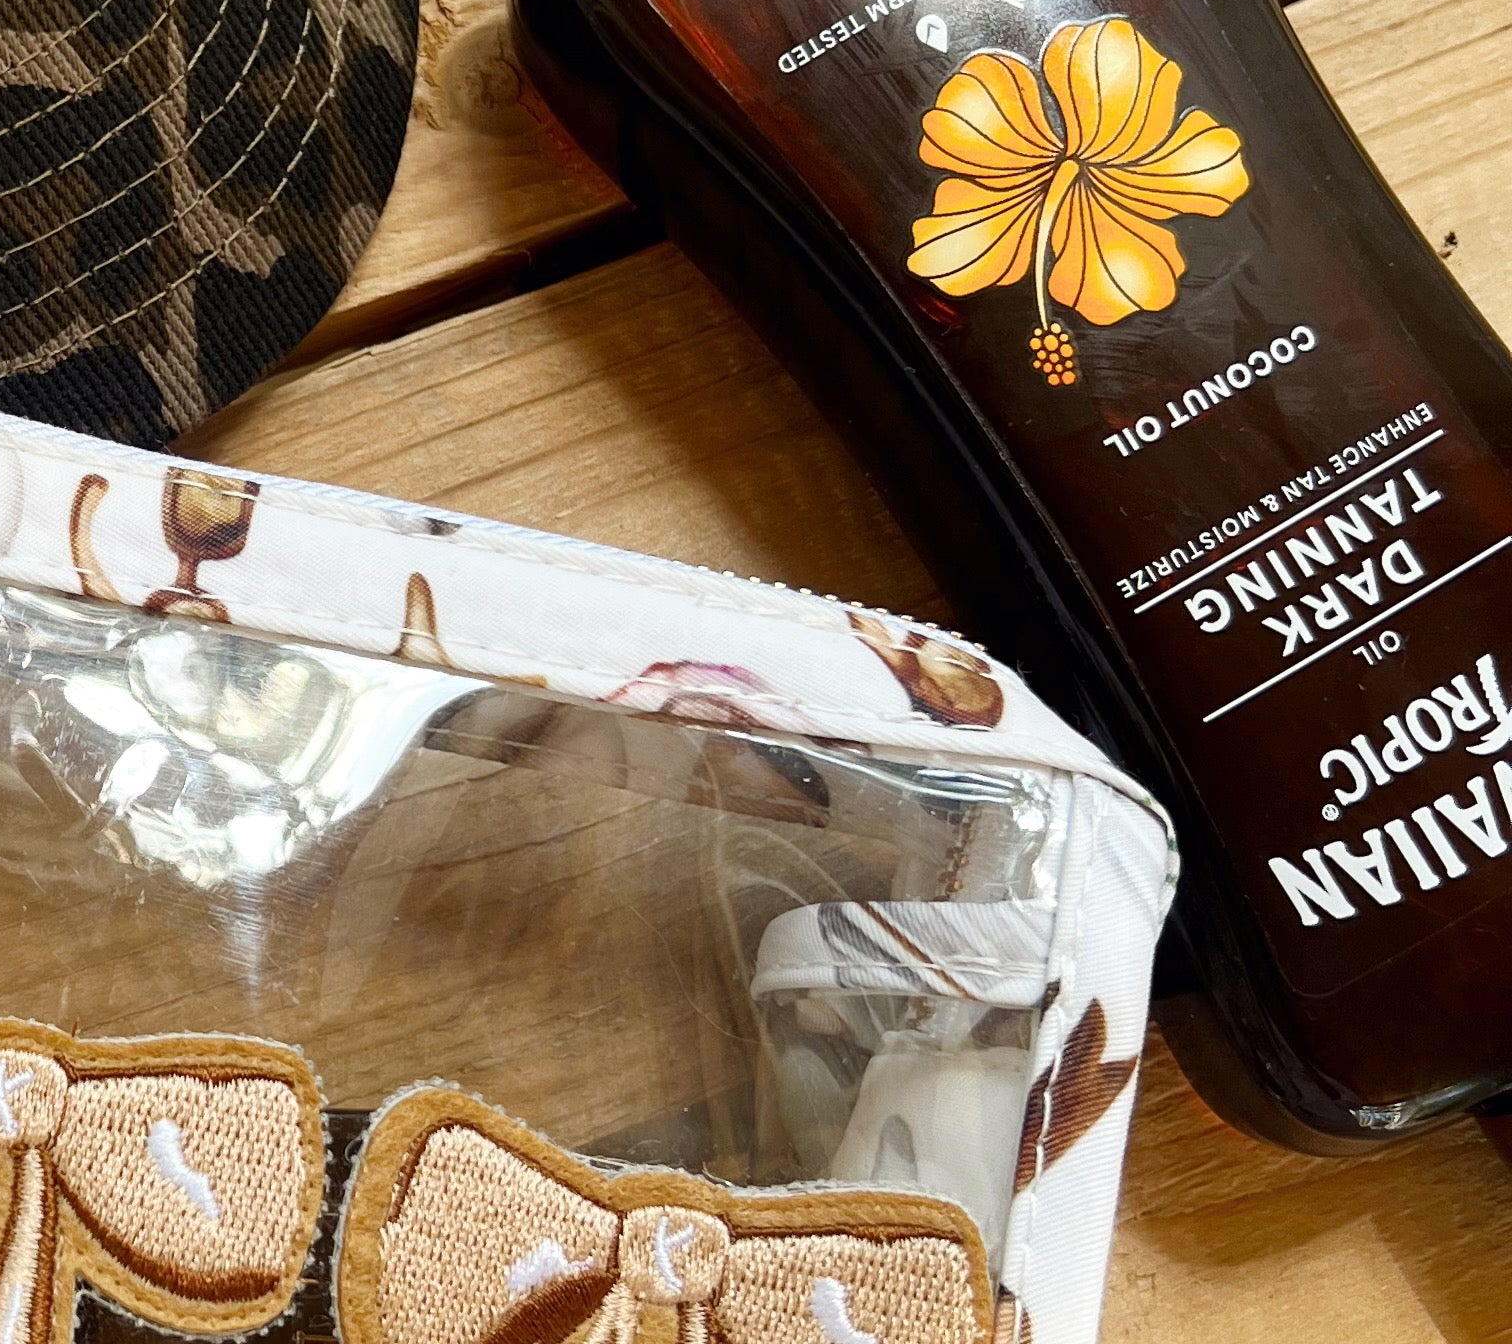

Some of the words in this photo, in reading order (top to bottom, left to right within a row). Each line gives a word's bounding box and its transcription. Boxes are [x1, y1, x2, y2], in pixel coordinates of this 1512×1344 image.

[777, 13, 866, 74] TESTED
[1165, 325, 1317, 429] COCONUT
[1103, 416, 1163, 457] OIL
[1328, 402, 1435, 474] ENHANCE
[1259, 494, 1280, 513] &
[1281, 464, 1331, 502] TAN
[1116, 505, 1262, 599] MOISTURIZE
[1184, 468, 1444, 634] TANNING
[1261, 539, 1426, 657] DARK
[1353, 630, 1402, 666] OIL
[1268, 760, 1511, 926] AIIAN
